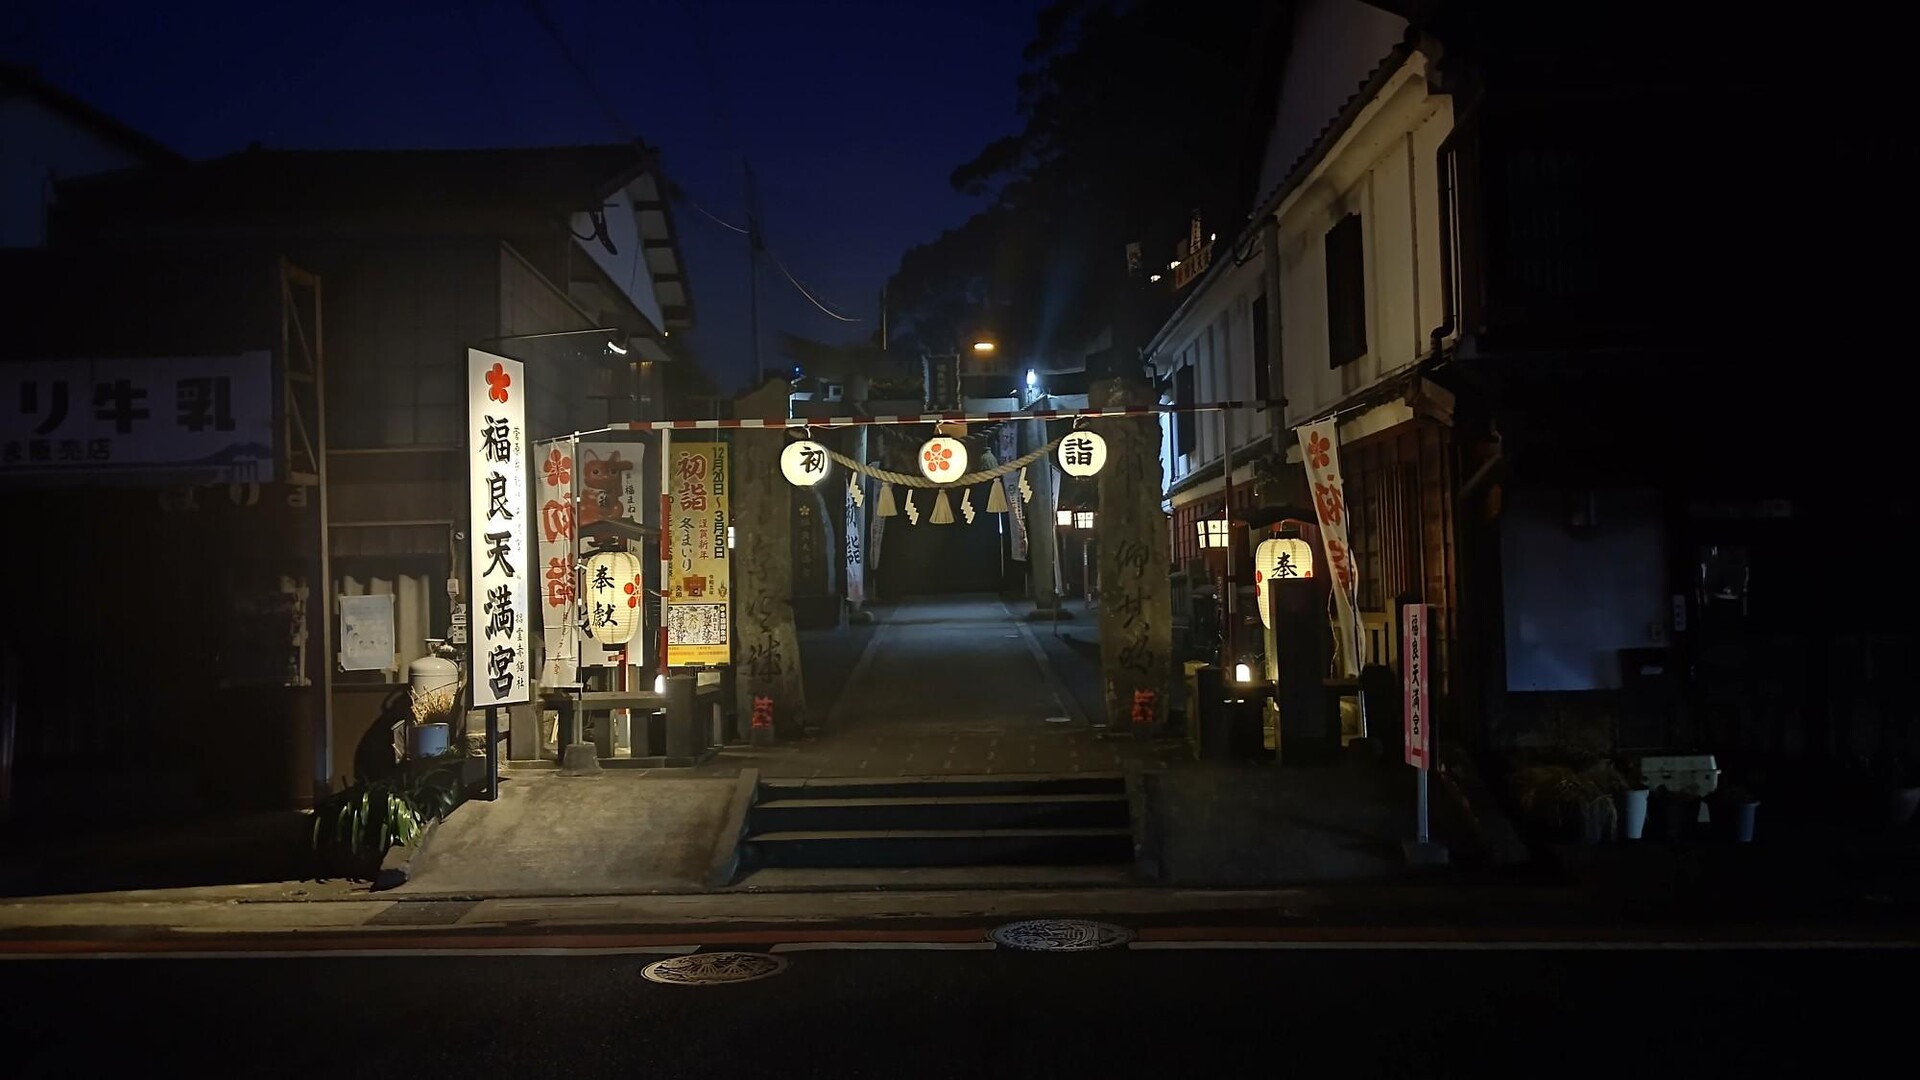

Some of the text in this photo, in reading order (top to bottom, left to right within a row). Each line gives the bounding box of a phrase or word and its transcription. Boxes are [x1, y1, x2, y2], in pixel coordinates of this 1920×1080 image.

[19, 376, 236, 435] リ牛乳
[799, 446, 826, 474] 初
[1066, 438, 1095, 468] 詣
[676, 452, 708, 512] 初詣
[479, 414, 514, 700] 福良天満宮
[679, 517, 695, 572] 冬まいり
[1272, 551, 1298, 579] 奉
